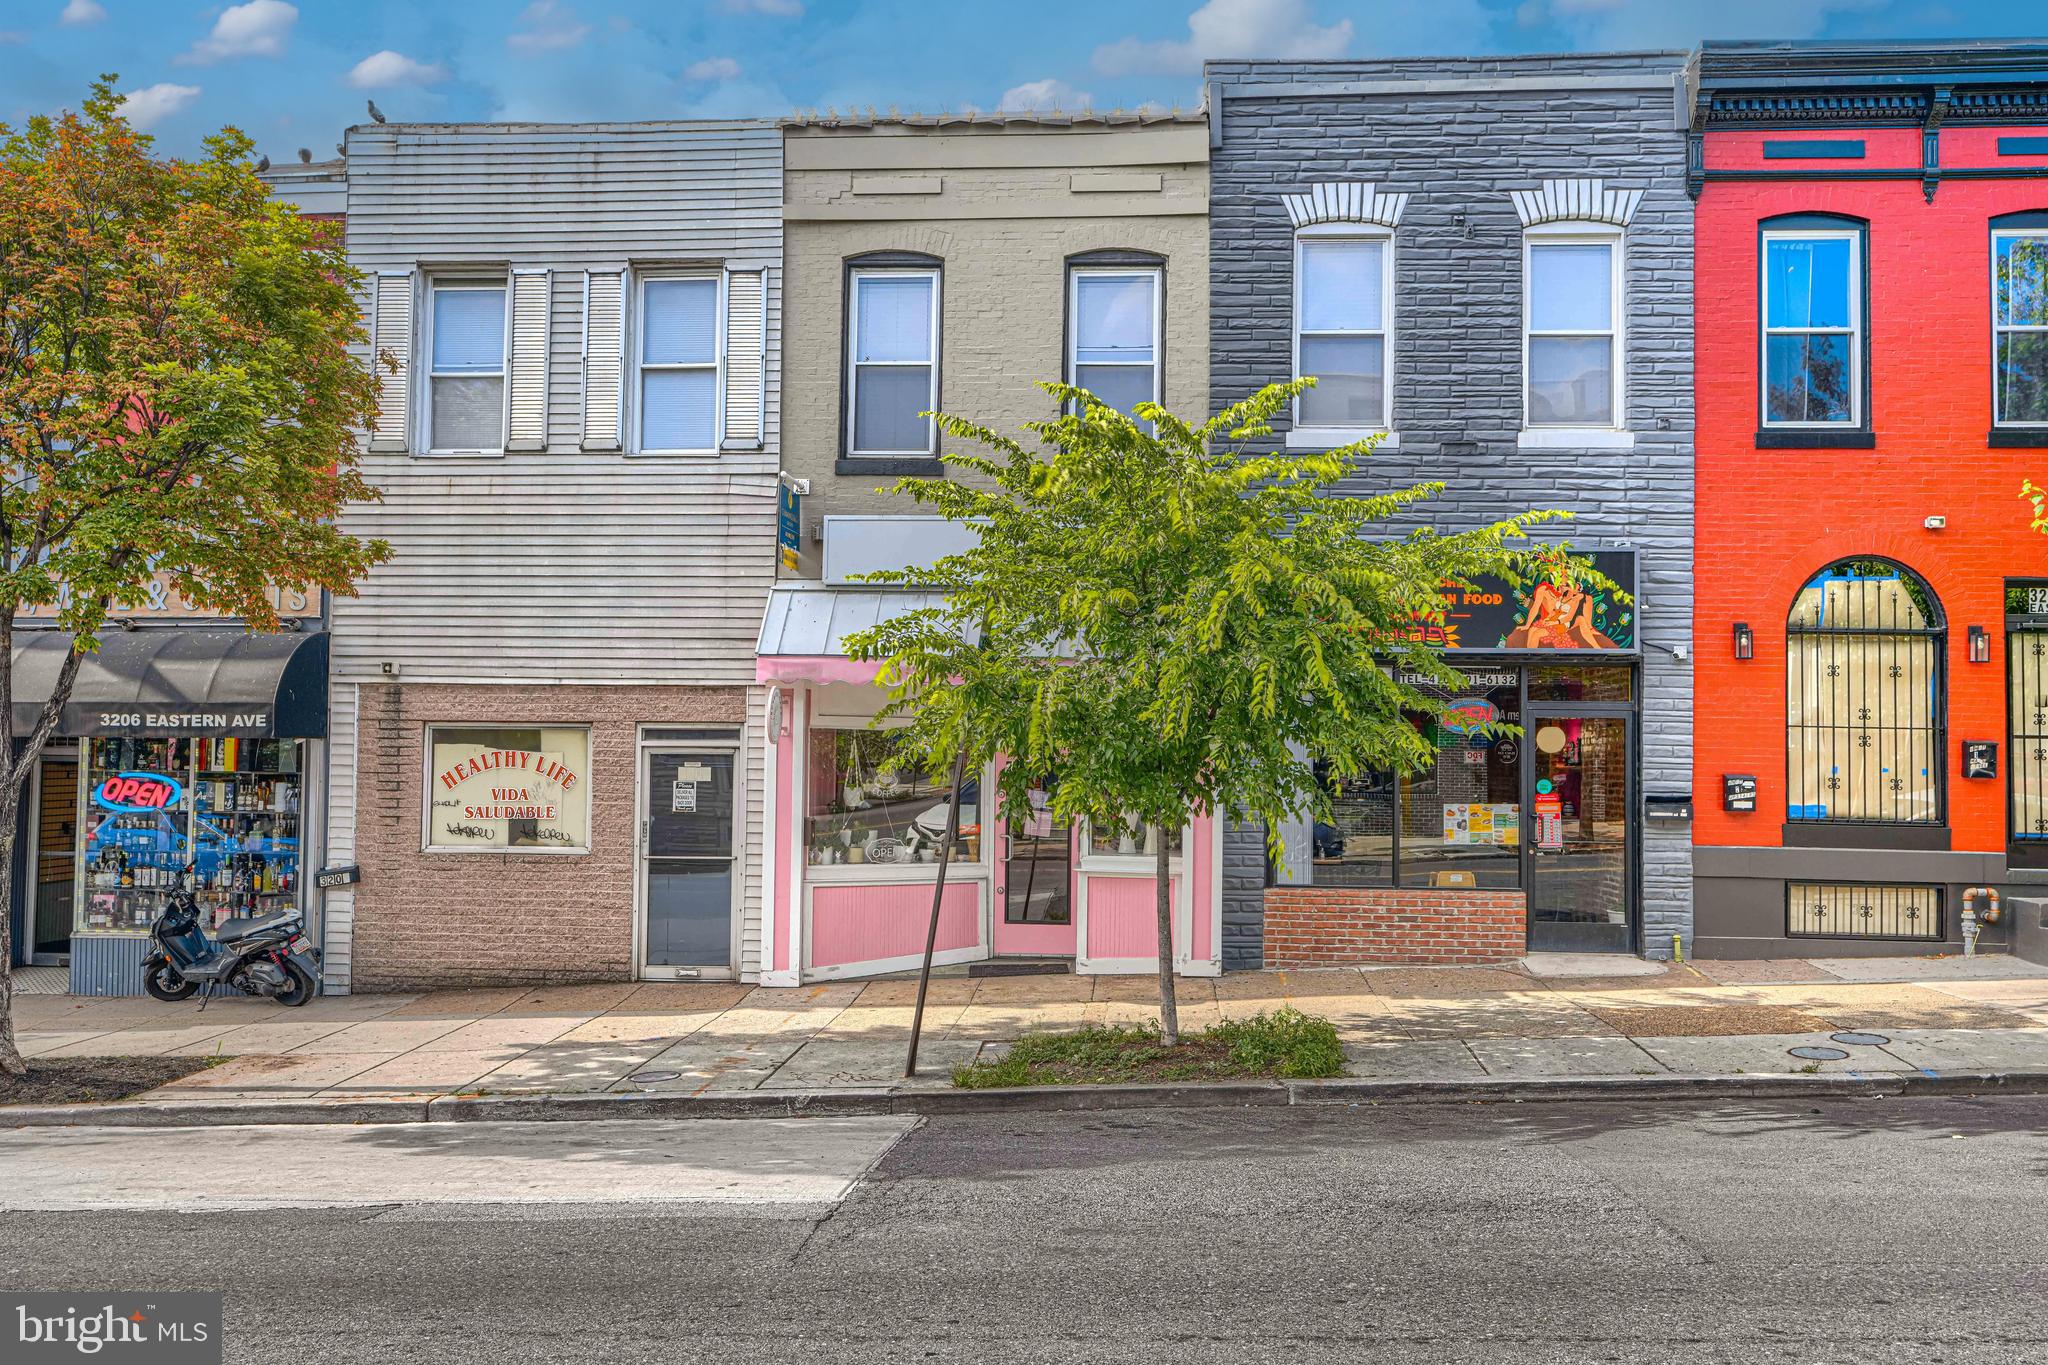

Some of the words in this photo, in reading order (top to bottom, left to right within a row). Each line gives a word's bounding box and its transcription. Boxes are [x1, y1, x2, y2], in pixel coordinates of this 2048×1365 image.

[147, 580, 168, 611] &
[1463, 593, 1503, 605] FOOD
[100, 713, 141, 727] 3206
[146, 713, 229, 727] EASTERN
[231, 713, 267, 727] AVE
[440, 751, 531, 791] HEALTHY
[534, 755, 577, 791] LIFE
[102, 777, 172, 808] OPEN
[491, 788, 529, 801] VIDA
[464, 805, 556, 819] SALUDABLE
